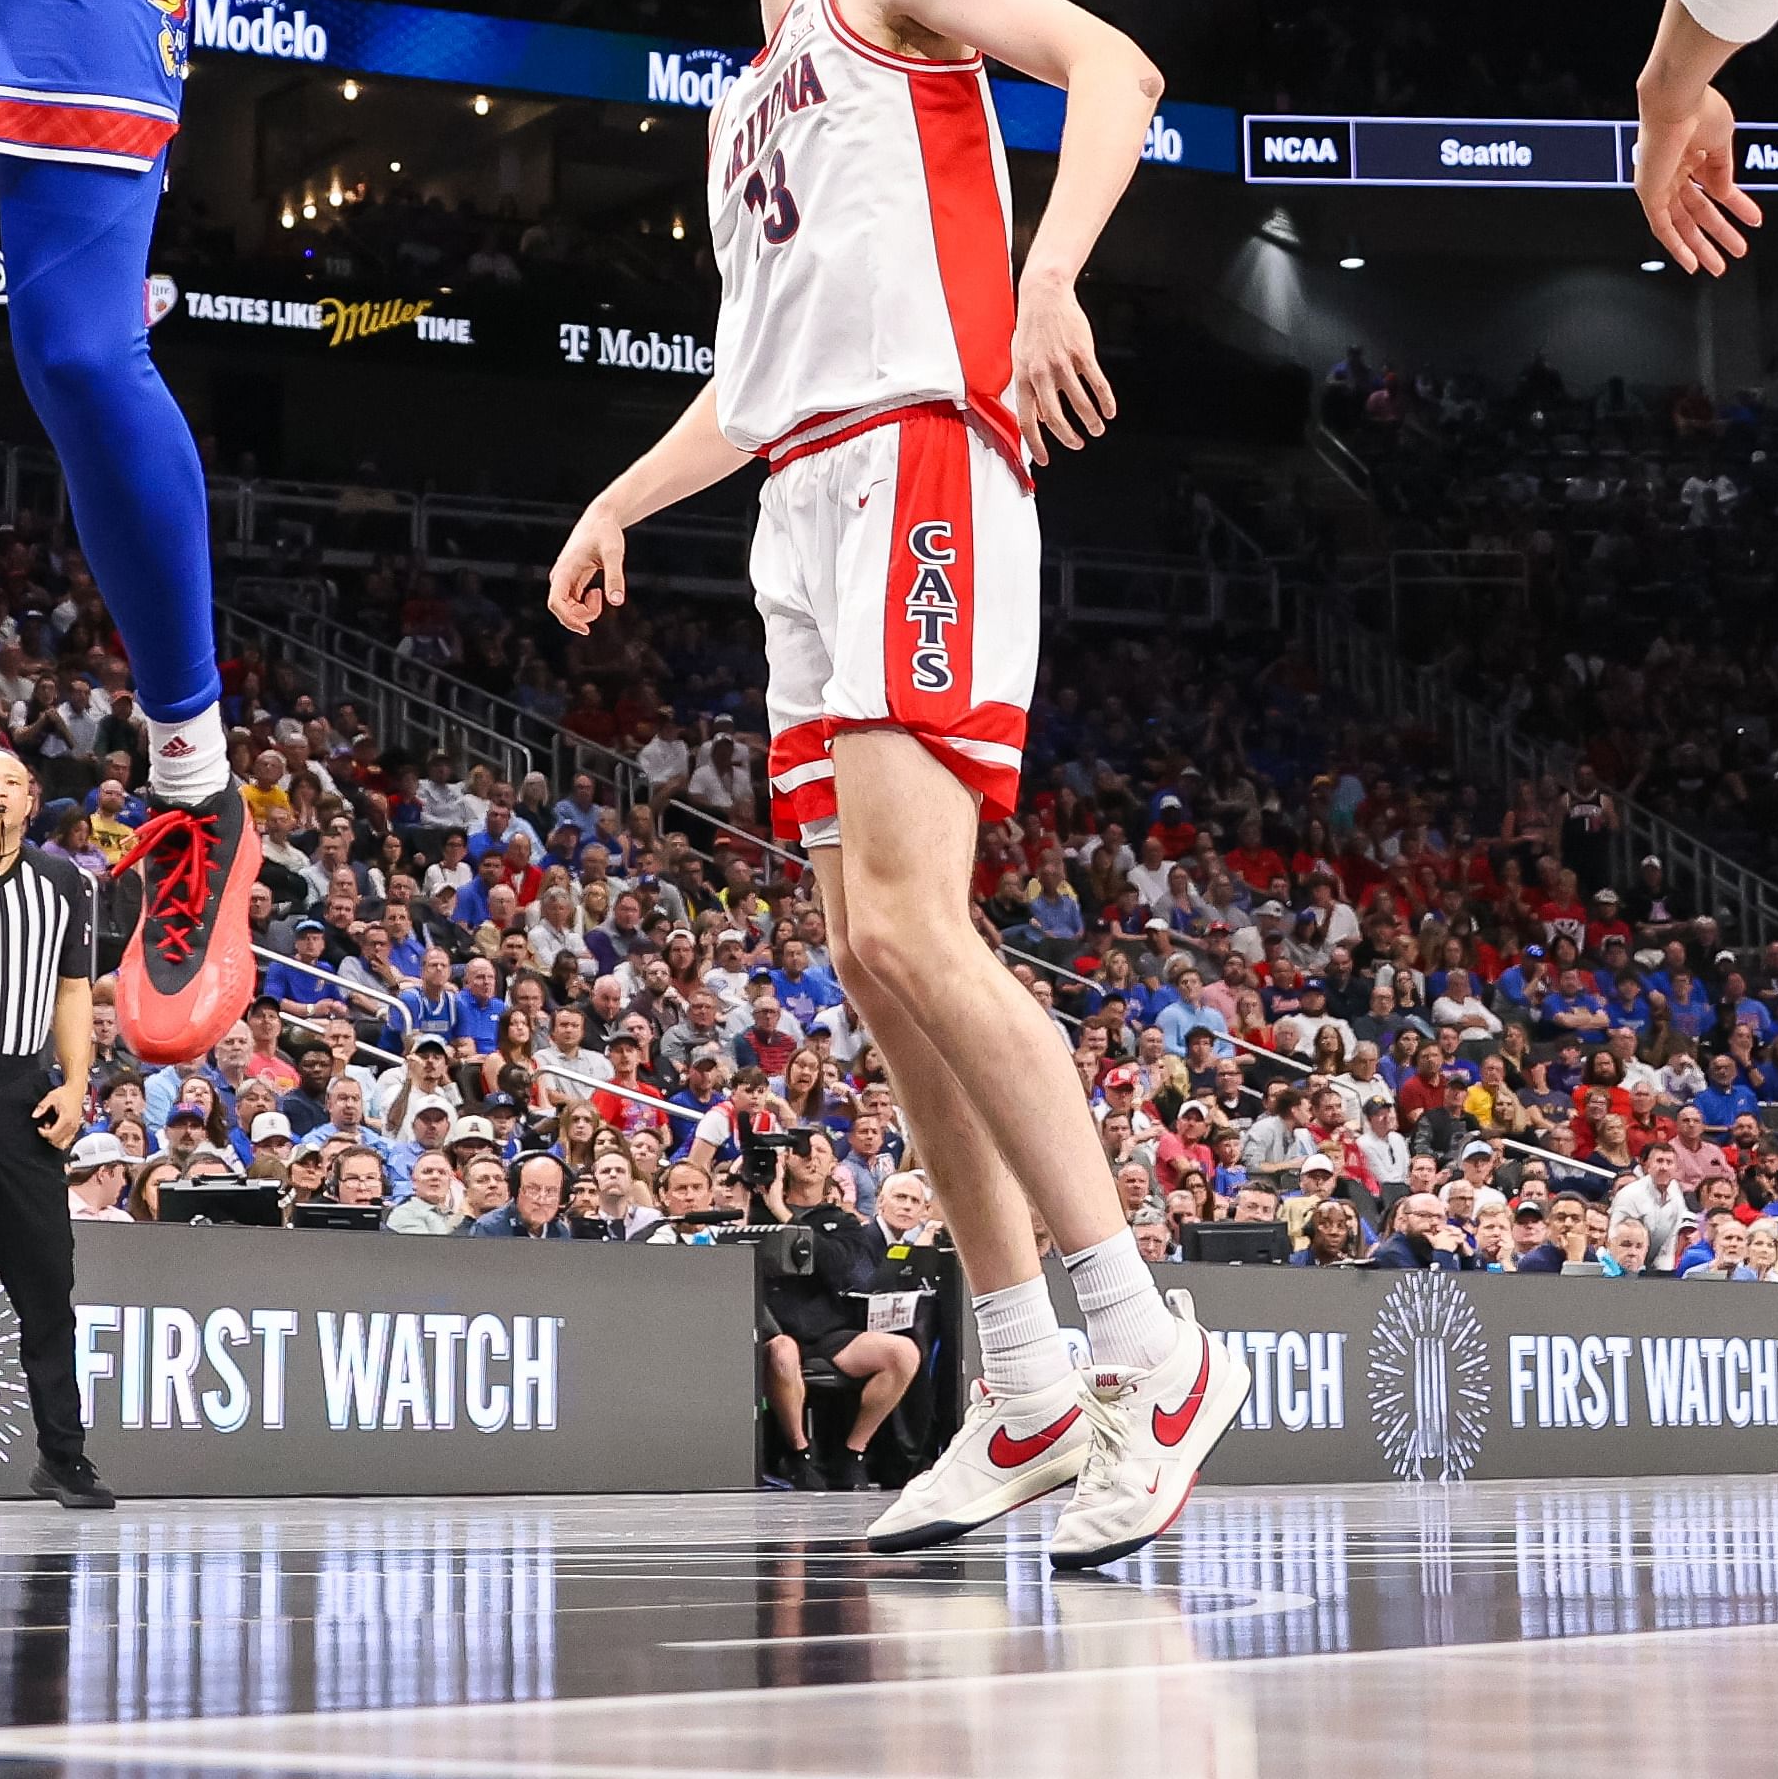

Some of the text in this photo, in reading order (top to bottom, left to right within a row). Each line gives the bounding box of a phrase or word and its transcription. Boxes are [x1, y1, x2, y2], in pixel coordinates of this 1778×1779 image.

[1264, 137, 1338, 163] NCAA
[1440, 138, 1532, 167] Seattle
[185, 291, 472, 347] TASTES LIKE Miller TIME
[559, 323, 714, 375] T Mobile
[905, 520, 958, 693] CATS
[74, 1303, 559, 1434] FIRST WATCH
[1095, 1373, 1120, 1388] BOOK
[1509, 1335, 1632, 1429] FIRST
